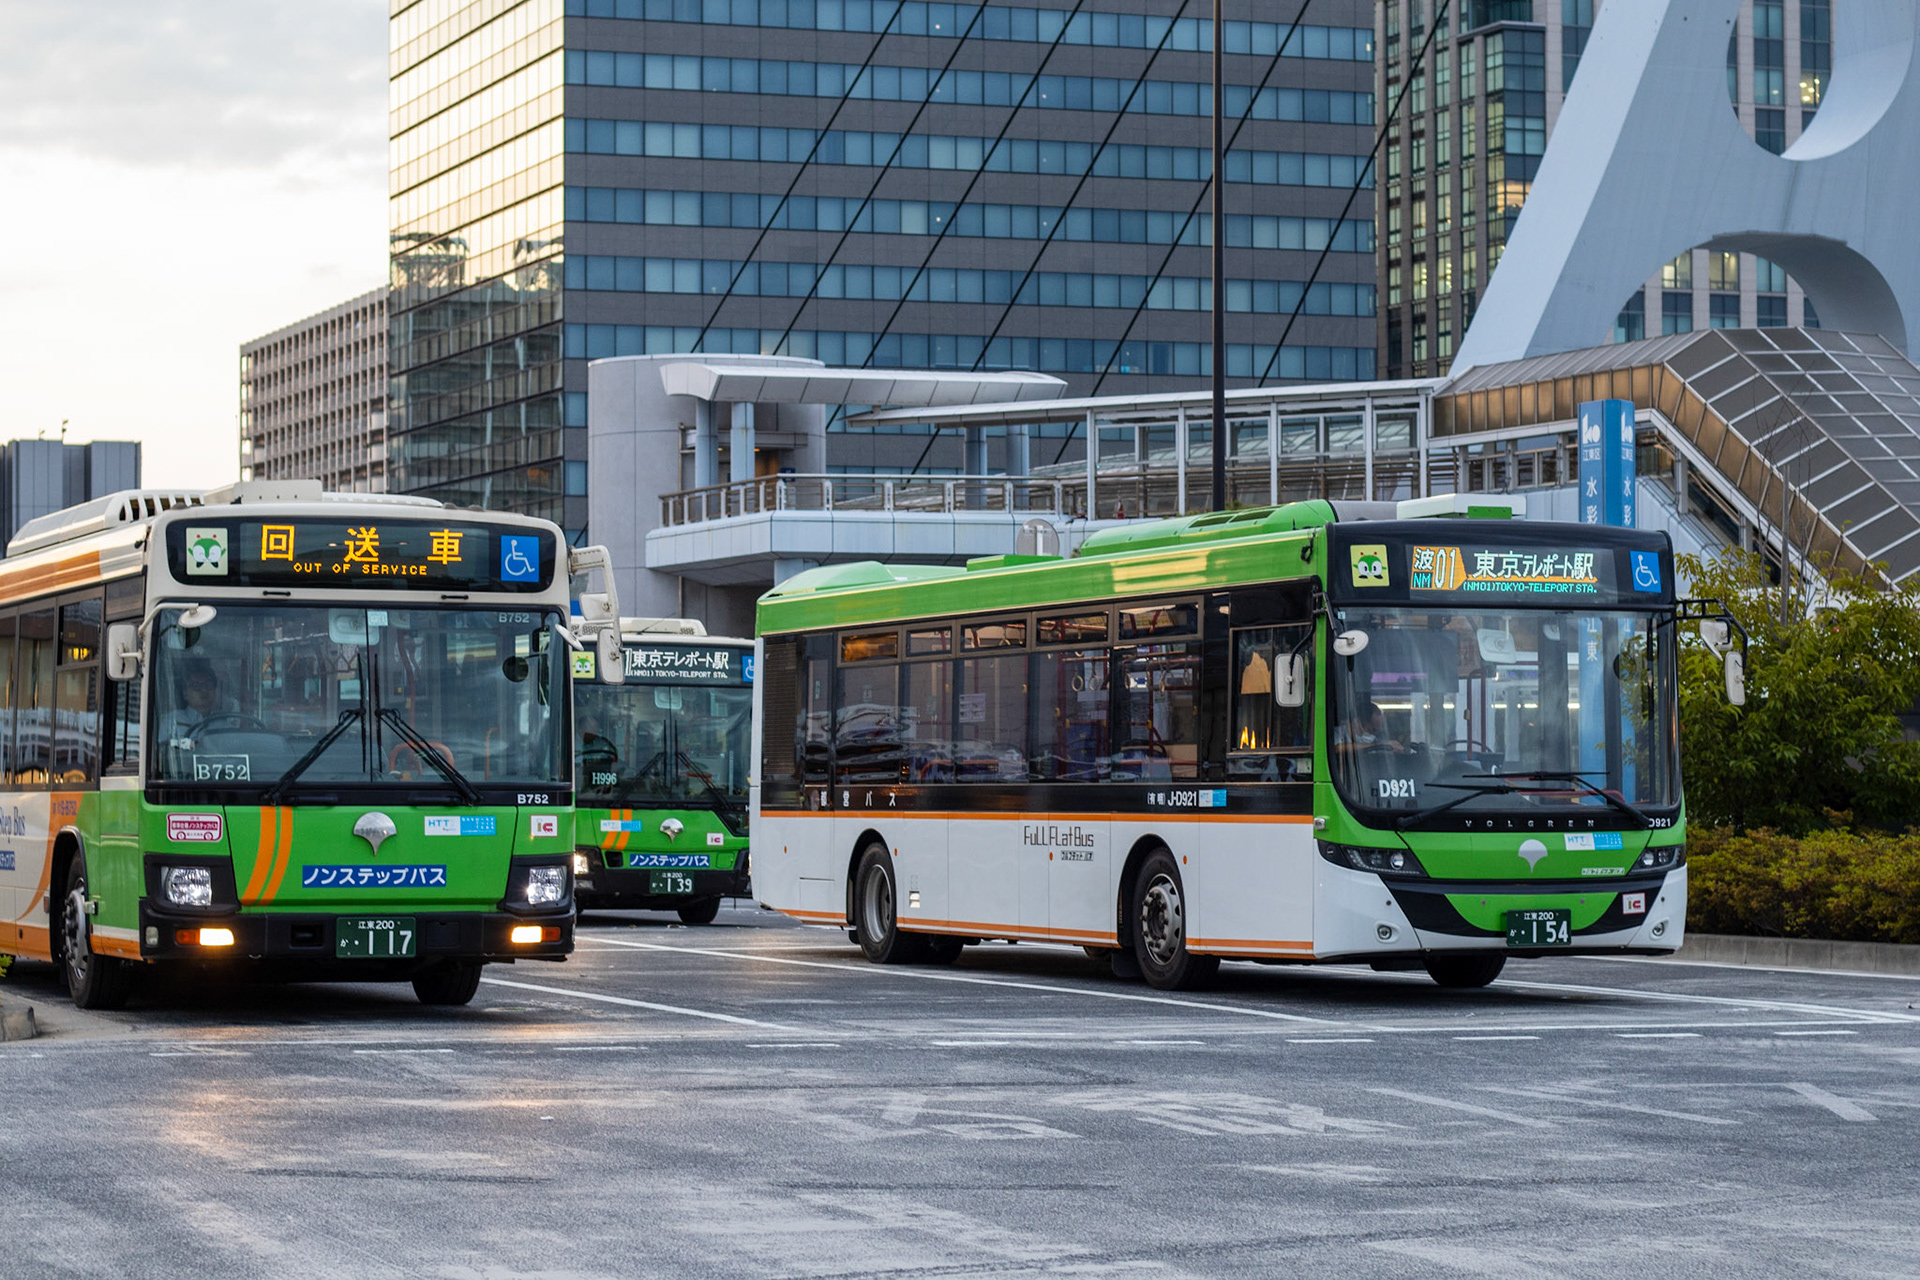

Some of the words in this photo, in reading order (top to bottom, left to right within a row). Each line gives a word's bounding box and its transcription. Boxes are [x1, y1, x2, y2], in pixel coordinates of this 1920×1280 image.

[261, 525, 463, 564] 回送車
[293, 562, 322, 573] OUT
[332, 563, 351, 573] OF
[362, 564, 428, 575] SERVICE
[1472, 550, 1594, 580] 東京テレポート駅
[1413, 573, 1431, 588] NM
[498, 612, 530, 623] B752
[632, 649, 729, 670] 東京テレポート駅
[197, 764, 247, 780] B752
[591, 772, 617, 785] H996
[1378, 779, 1416, 797] D921
[517, 794, 549, 804] B752
[1167, 791, 1197, 806] J-D921
[1465, 819, 1595, 828] VOLGREN
[630, 855, 710, 867] ノンステップバス
[303, 867, 446, 885] ノンステップバス
